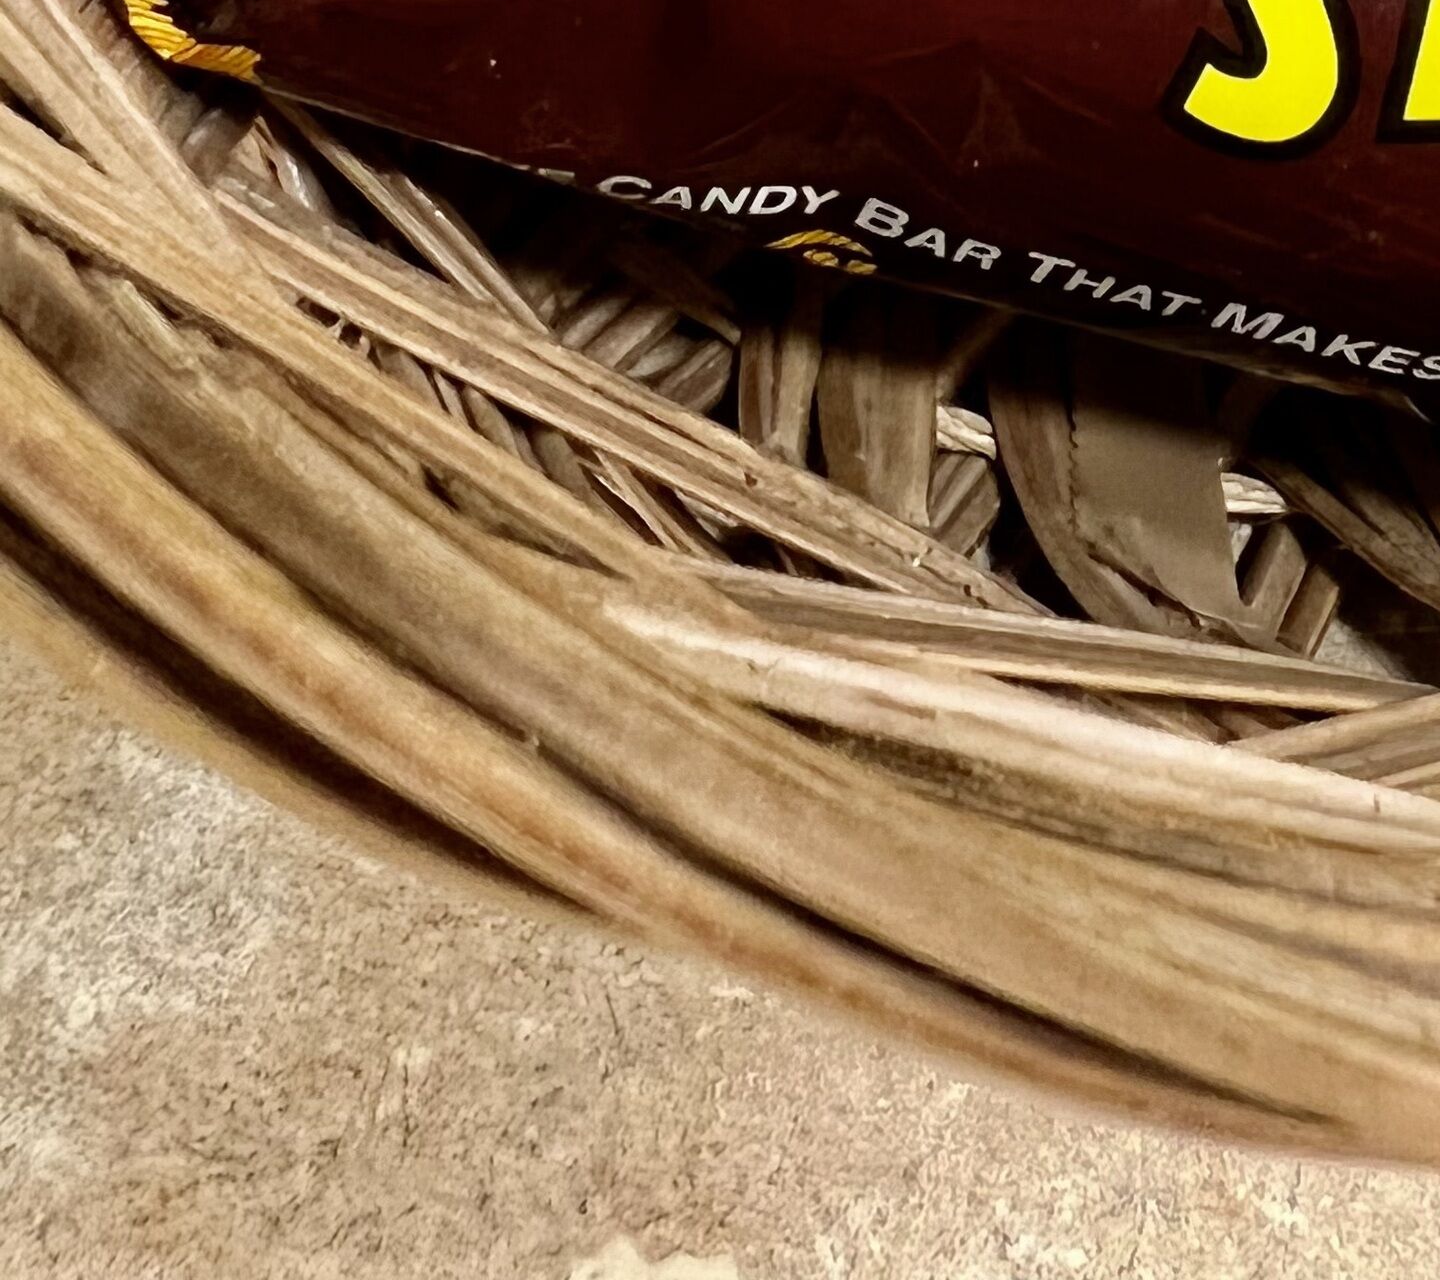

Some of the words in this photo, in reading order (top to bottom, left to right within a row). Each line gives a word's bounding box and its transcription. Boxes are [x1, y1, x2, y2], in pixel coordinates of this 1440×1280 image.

[595, 174, 841, 218] CANDY
[853, 196, 1003, 272] BAR
[1027, 250, 1204, 318] THAT
